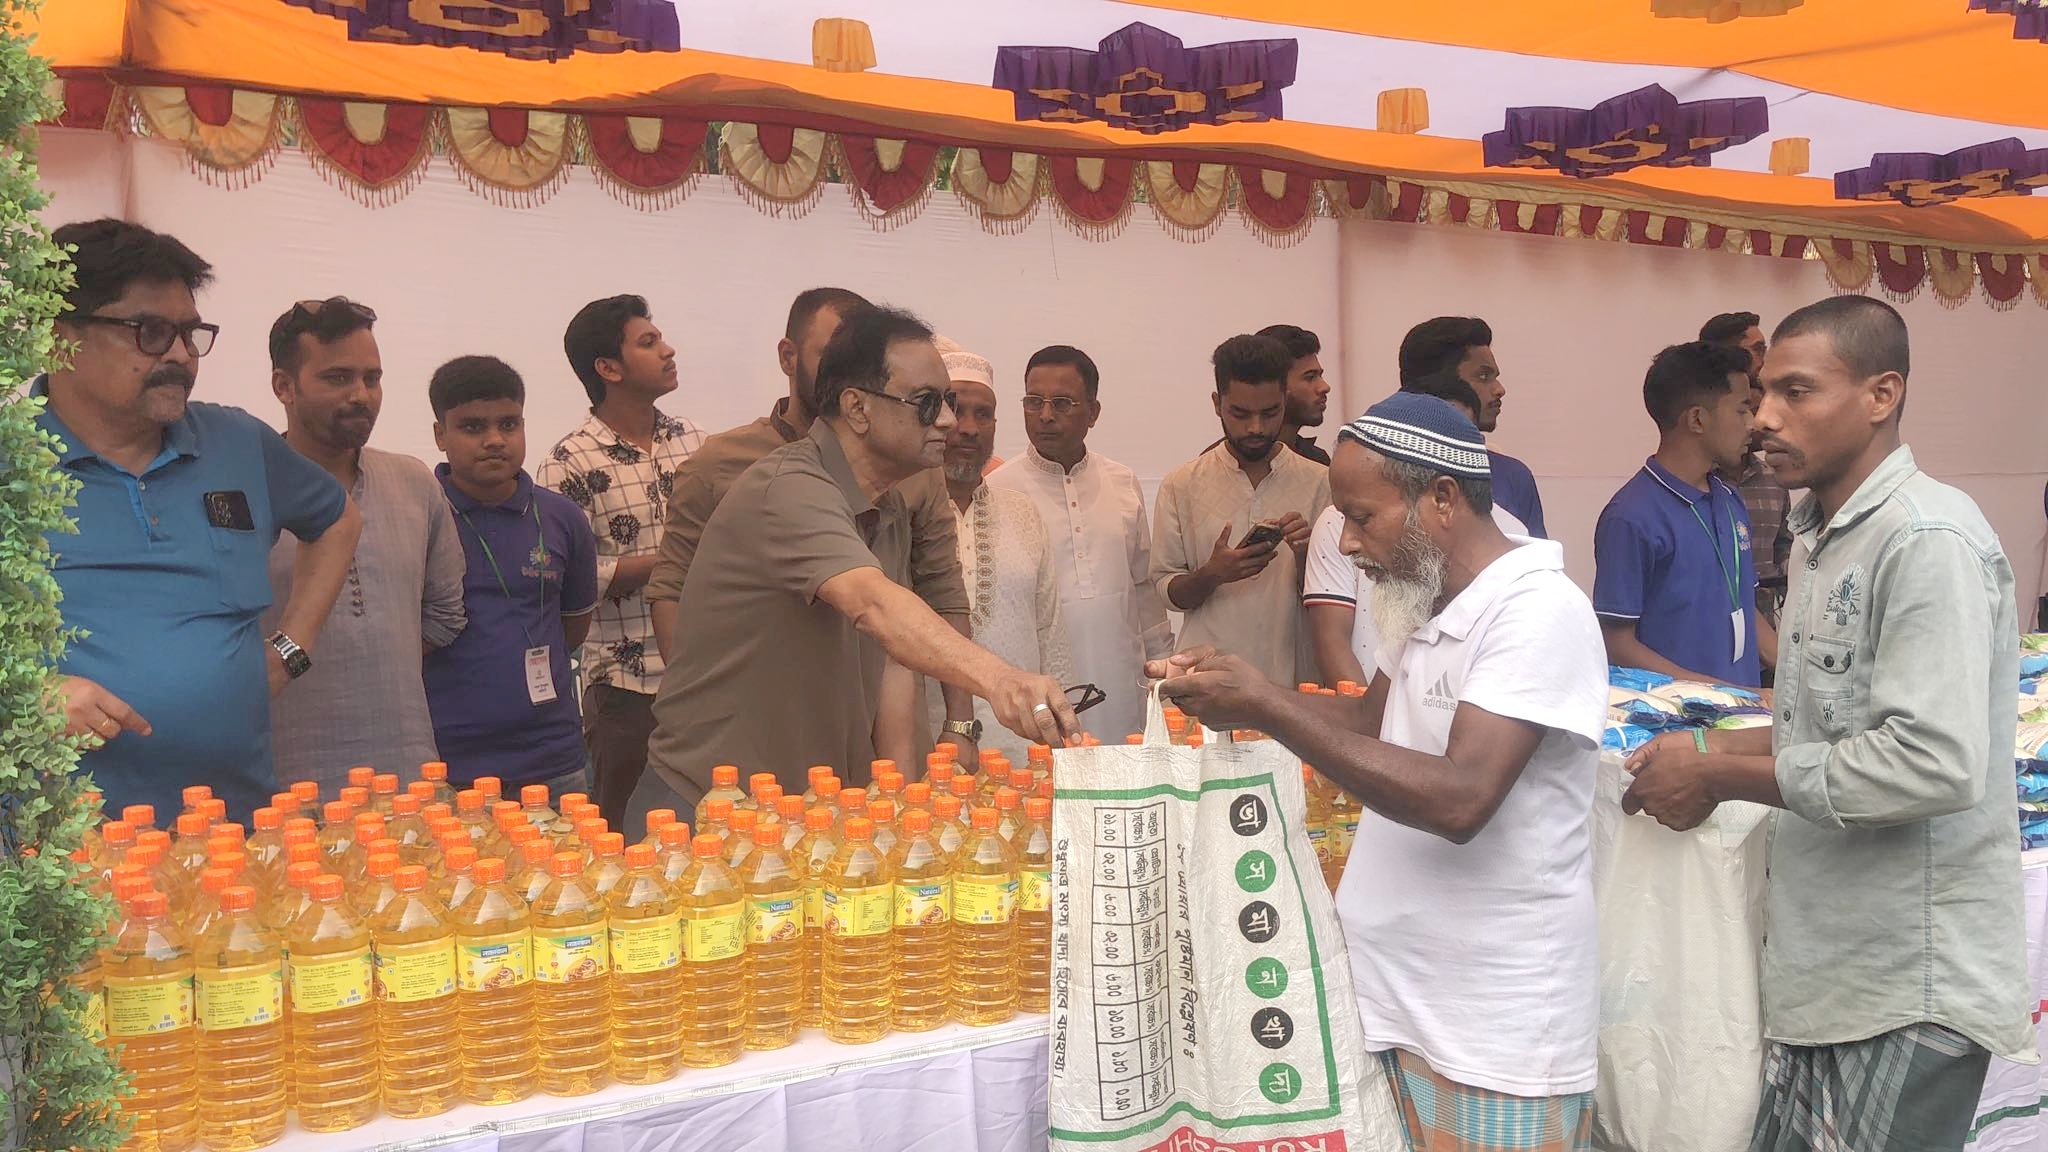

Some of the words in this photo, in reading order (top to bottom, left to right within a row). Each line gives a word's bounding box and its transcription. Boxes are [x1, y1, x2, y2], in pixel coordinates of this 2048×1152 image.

[1422, 697, 1456, 711] adidas
[1102, 852, 1116, 881] ৩২.০০
[1058, 891, 1070, 928] মৎস্য
[1103, 930, 1119, 960] ৩২.০০
